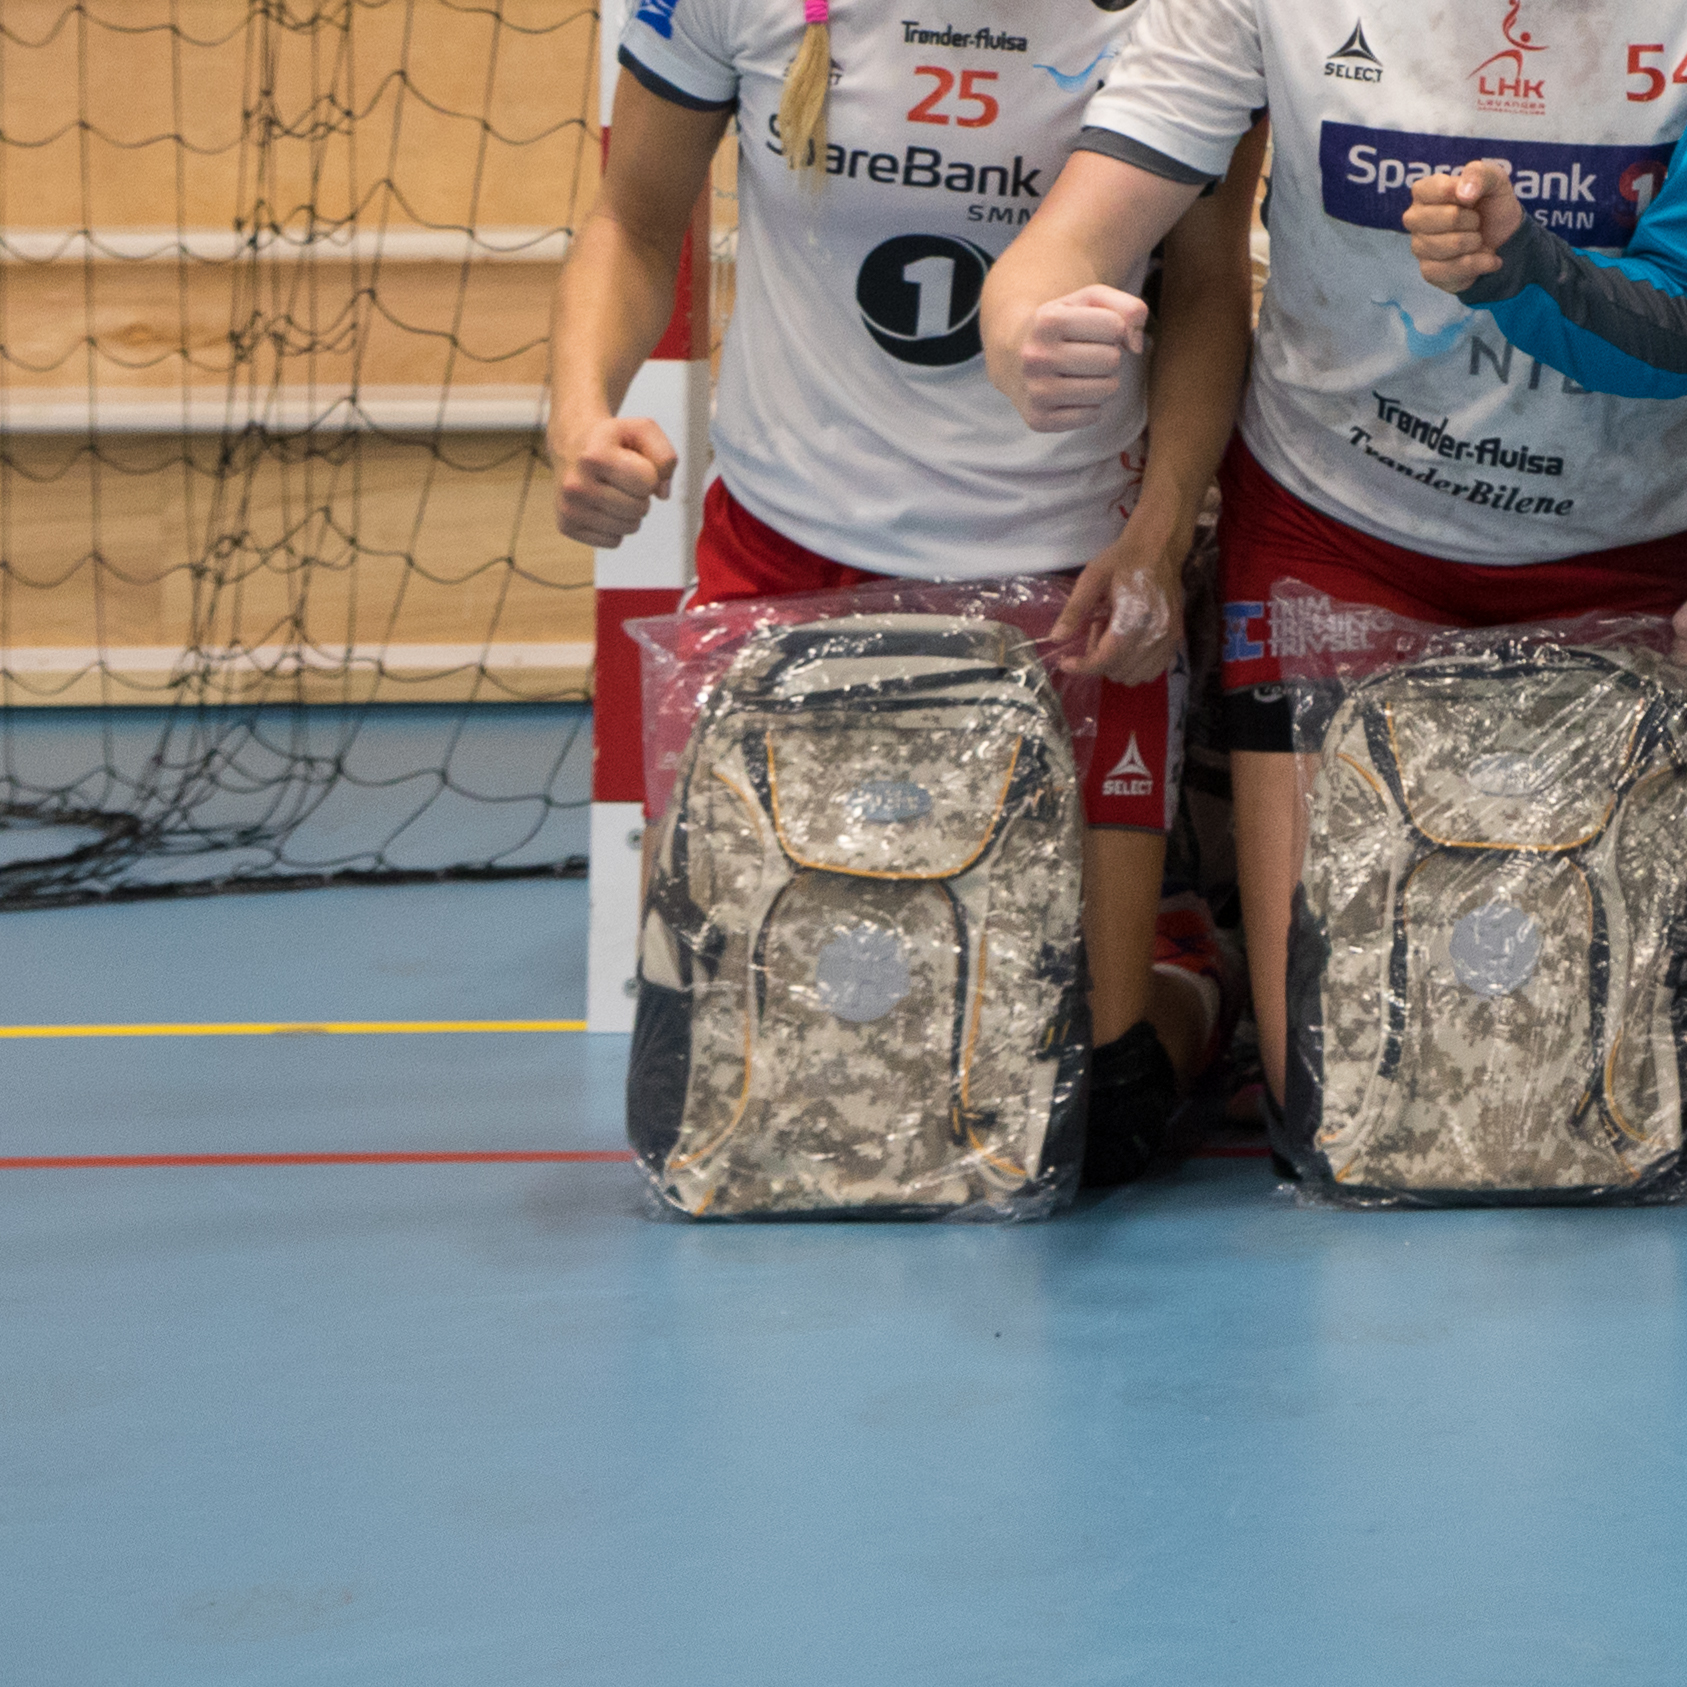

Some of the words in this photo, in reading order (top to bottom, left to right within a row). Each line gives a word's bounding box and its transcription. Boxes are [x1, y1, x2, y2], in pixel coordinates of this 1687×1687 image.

[1324, 61, 1383, 82] SELECT
[906, 65, 1001, 128] 25
[1479, 75, 1545, 99] LHK
[1102, 778, 1154, 796] SELECT
